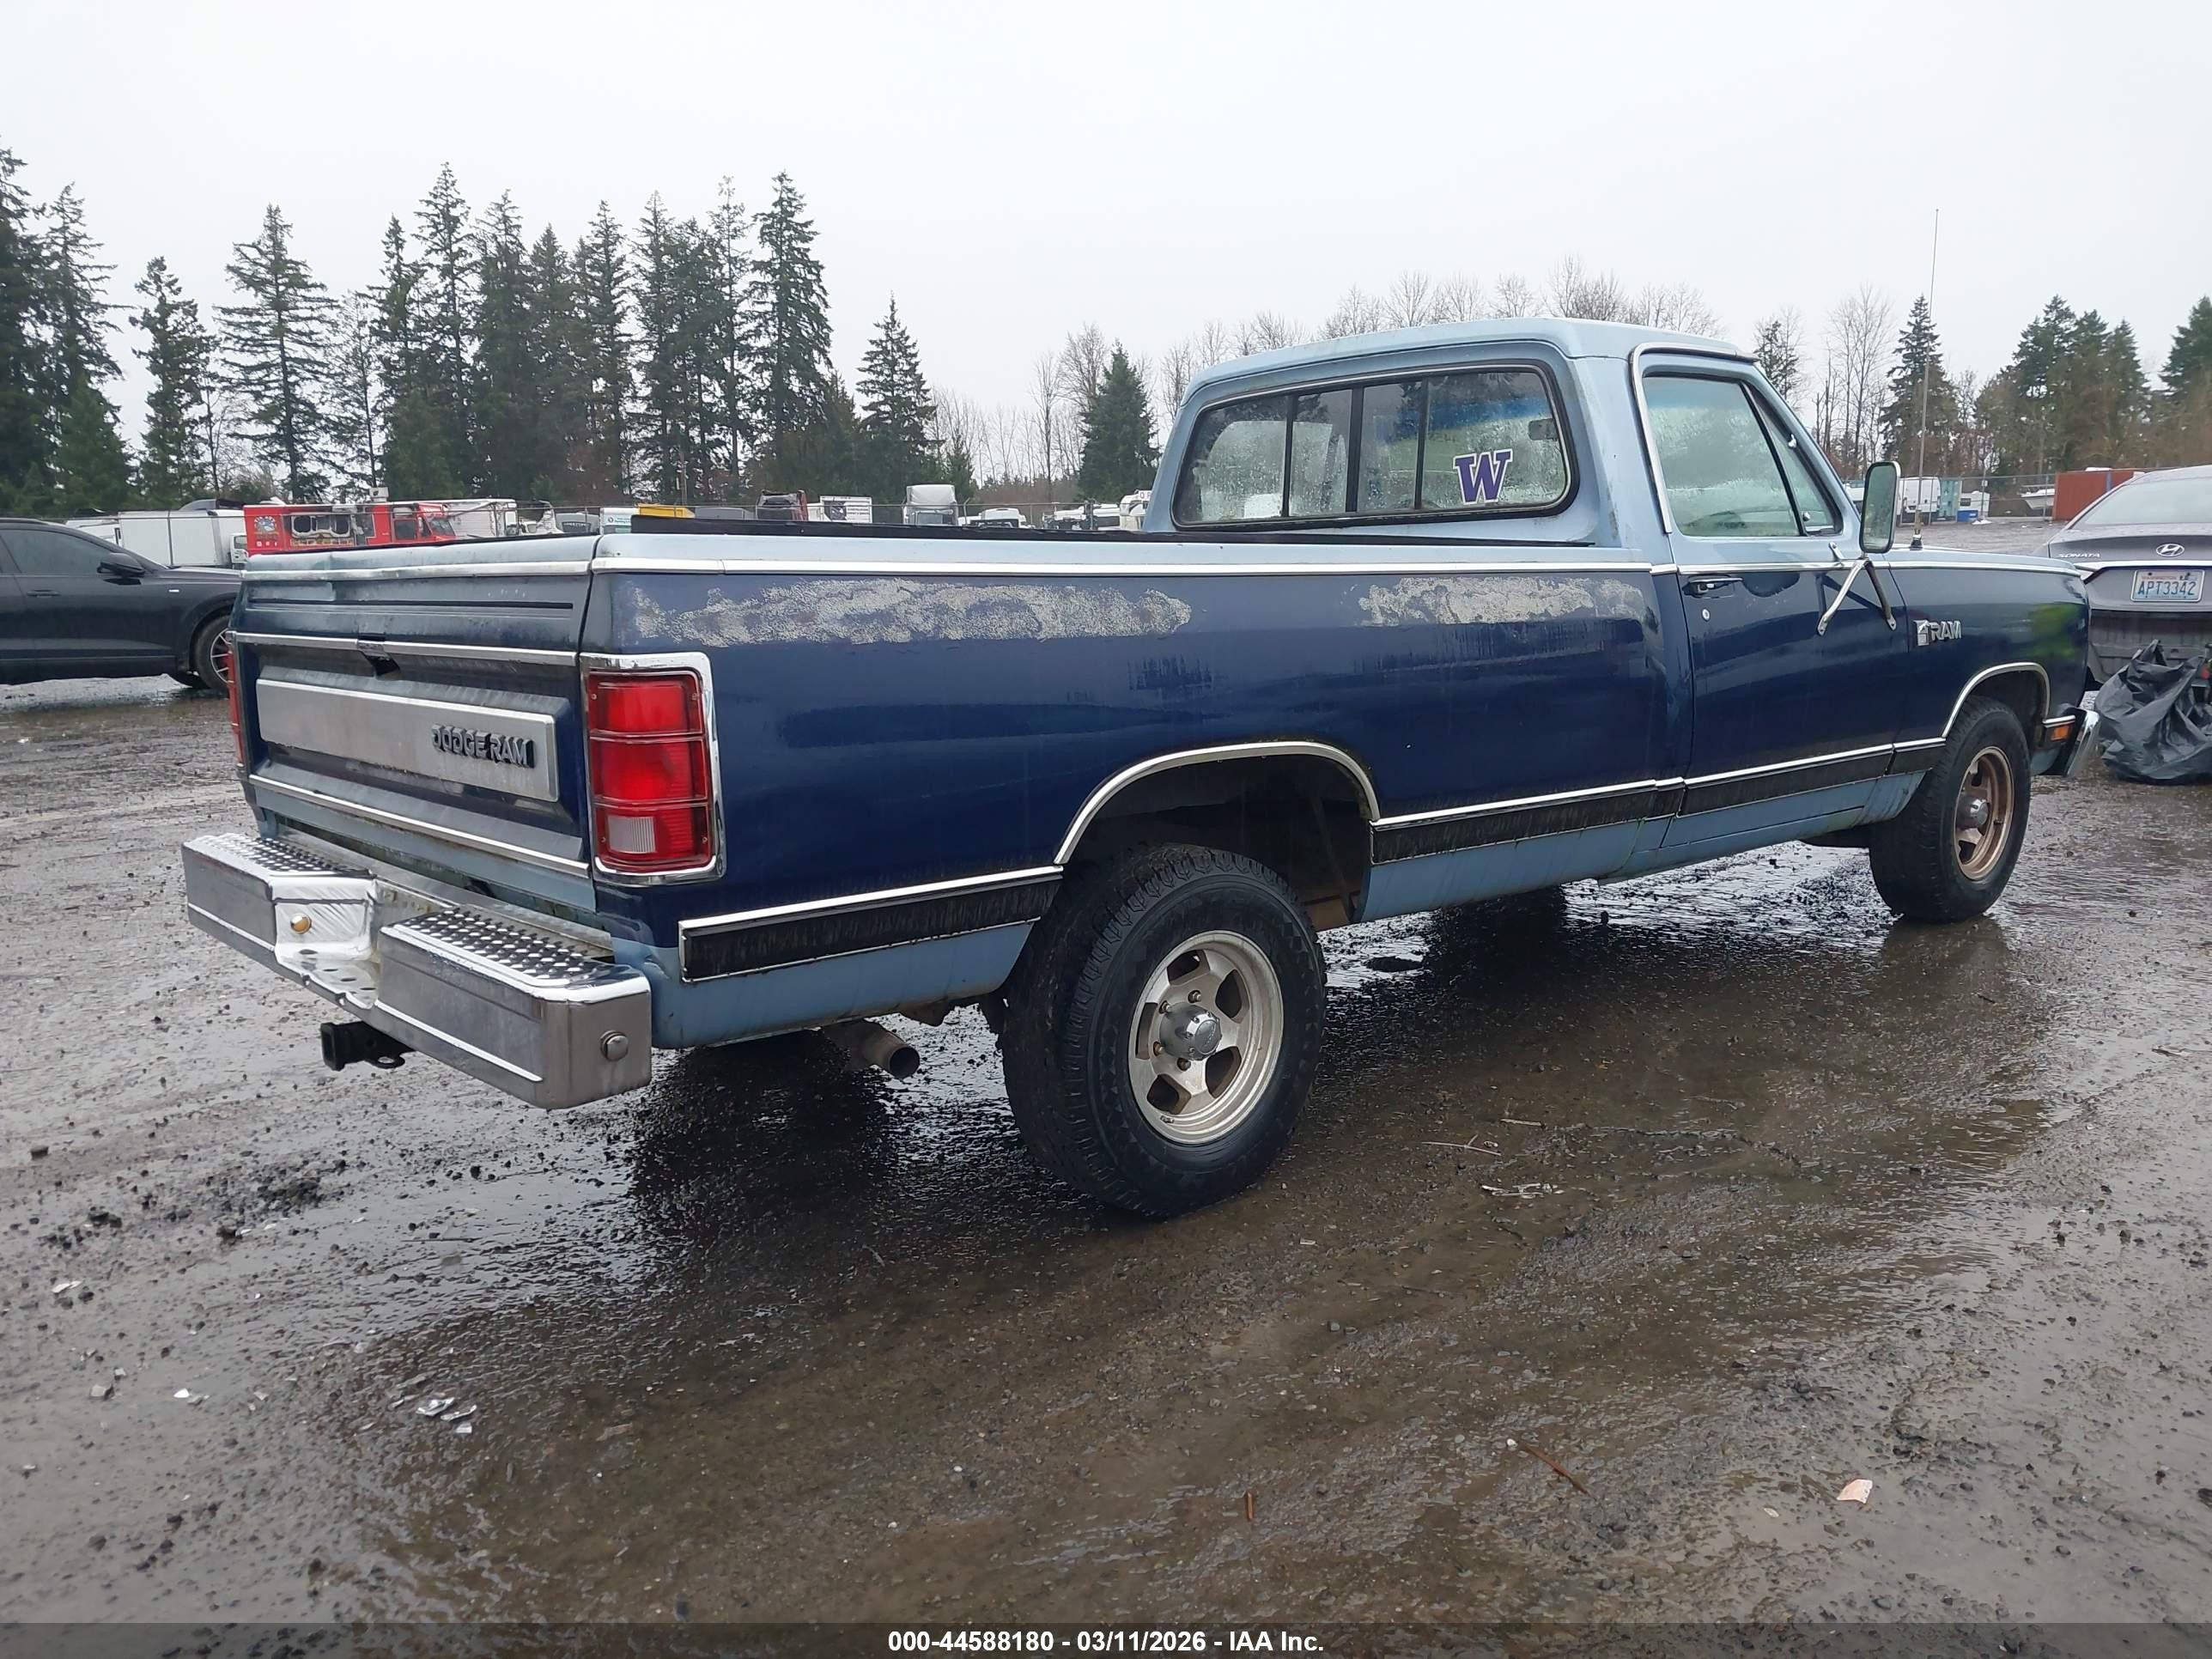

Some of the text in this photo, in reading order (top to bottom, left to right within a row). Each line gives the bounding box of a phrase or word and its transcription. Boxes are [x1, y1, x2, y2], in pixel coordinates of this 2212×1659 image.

[1453, 448, 1513, 505] W
[2137, 580, 2197, 596] APT3342
[1928, 621, 1962, 641] RAM
[431, 724, 535, 769] DODGE RAM
